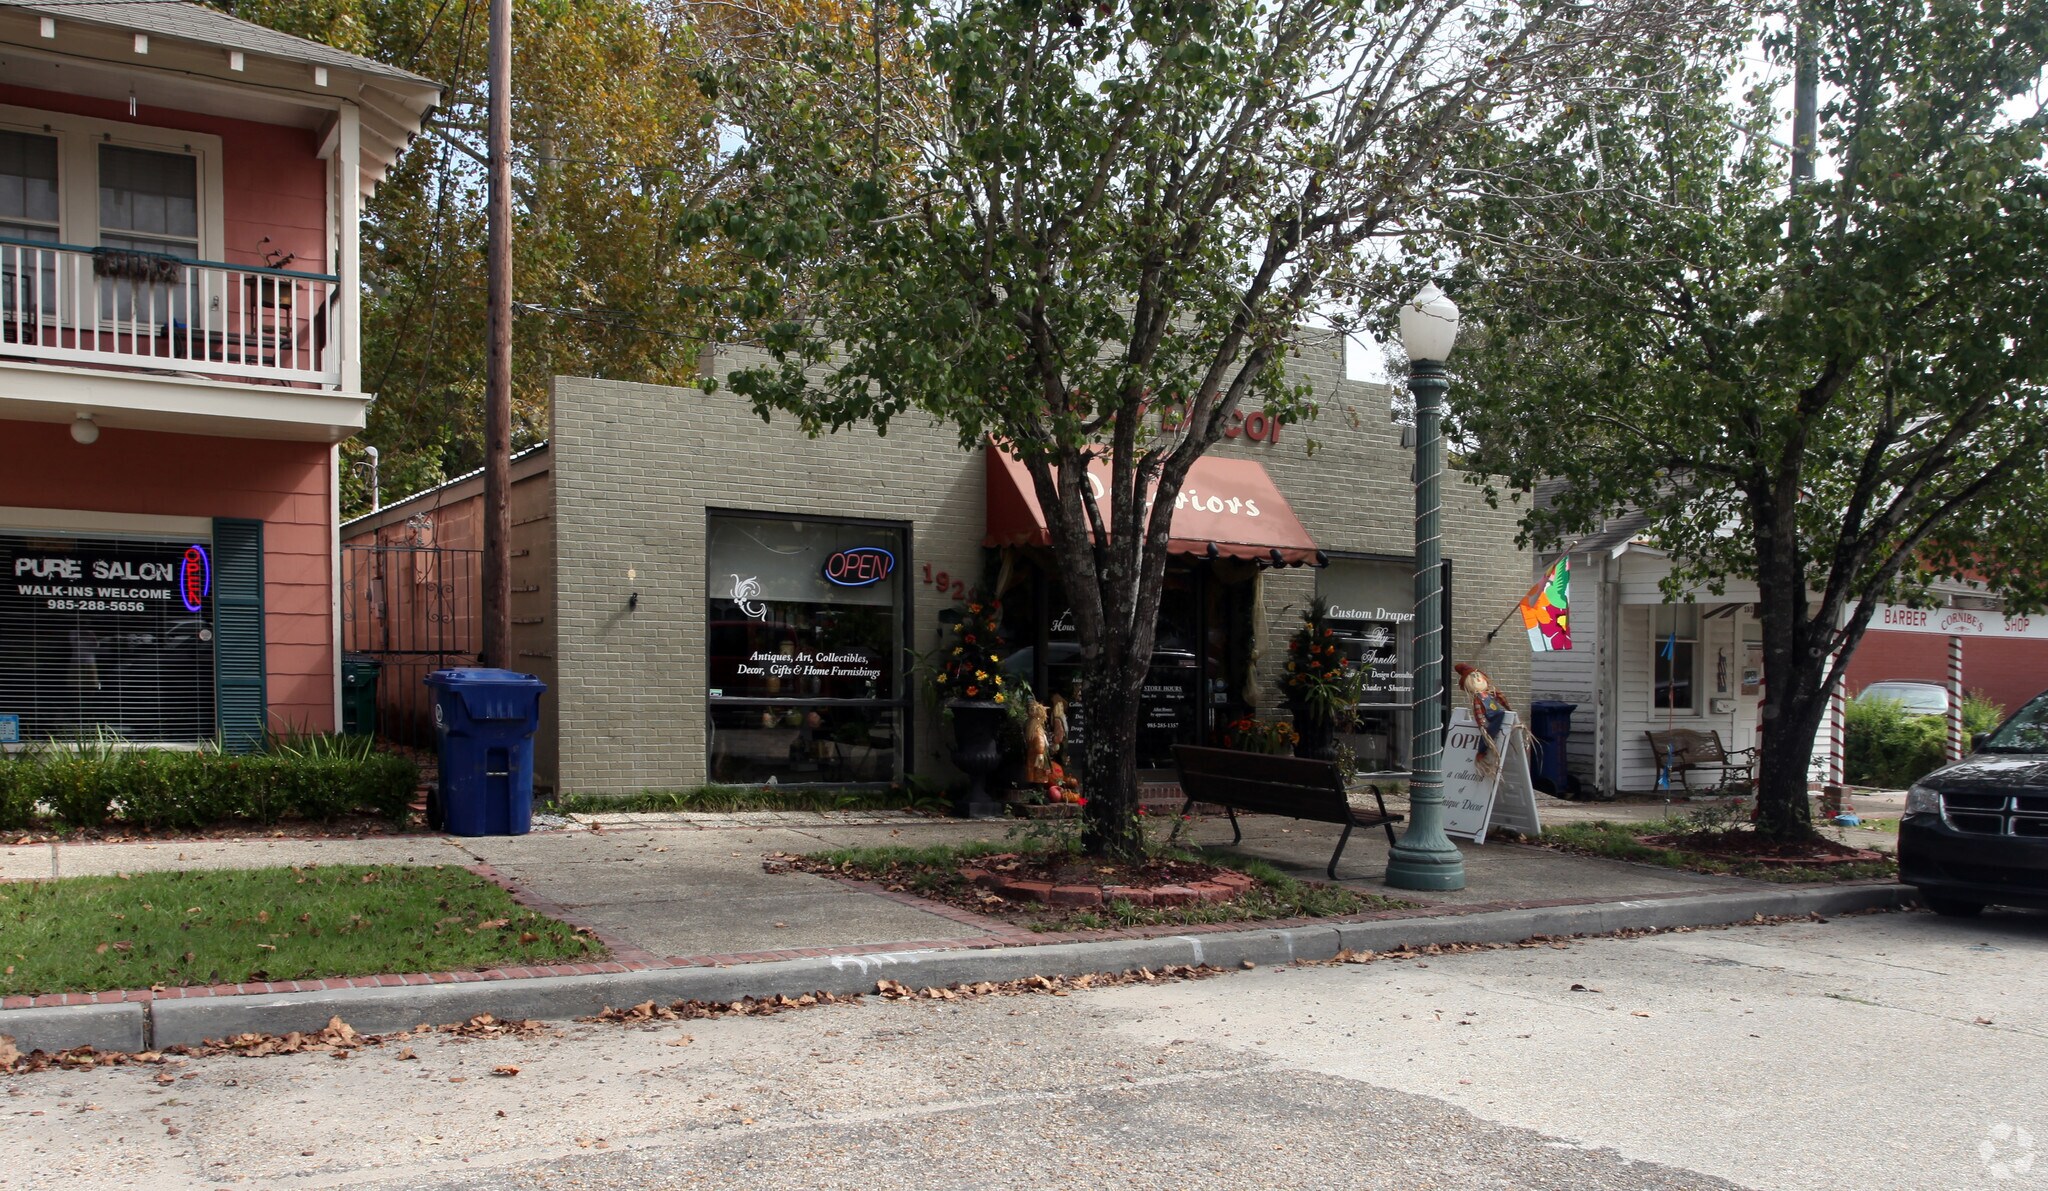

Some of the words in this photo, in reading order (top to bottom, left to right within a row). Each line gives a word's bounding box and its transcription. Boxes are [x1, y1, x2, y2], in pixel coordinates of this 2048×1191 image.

[1162, 391, 1284, 444] Dcor
[15, 558, 82, 581] PURE
[92, 561, 173, 582] SALON
[828, 552, 889, 580] OPEN
[185, 548, 200, 605] OPEN
[18, 585, 93, 597] WALK-INS
[97, 587, 171, 599] WELCOME
[47, 599, 145, 612] 985-288-5656
[1329, 605, 1372, 619] Custom
[1376, 607, 1415, 624] Draper
[1884, 609, 1927, 627] BARBER
[1940, 612, 1984, 633] CORNIBE'S
[2004, 617, 2030, 632] SHOP
[1050, 619, 1076, 632] Hous
[750, 651, 794, 662] Antiques,
[795, 652, 813, 663] Art,
[816, 652, 869, 665] Collectibles,
[737, 664, 765, 676] Decor,
[770, 665, 792, 678] Gifts
[793, 665, 802, 675] &
[803, 667, 829, 676] Home
[831, 666, 881, 680] Furnishings
[1371, 671, 1390, 681] Design
[1388, 684, 1411, 692] Shutters
[1462, 799, 1484, 812] Decor
